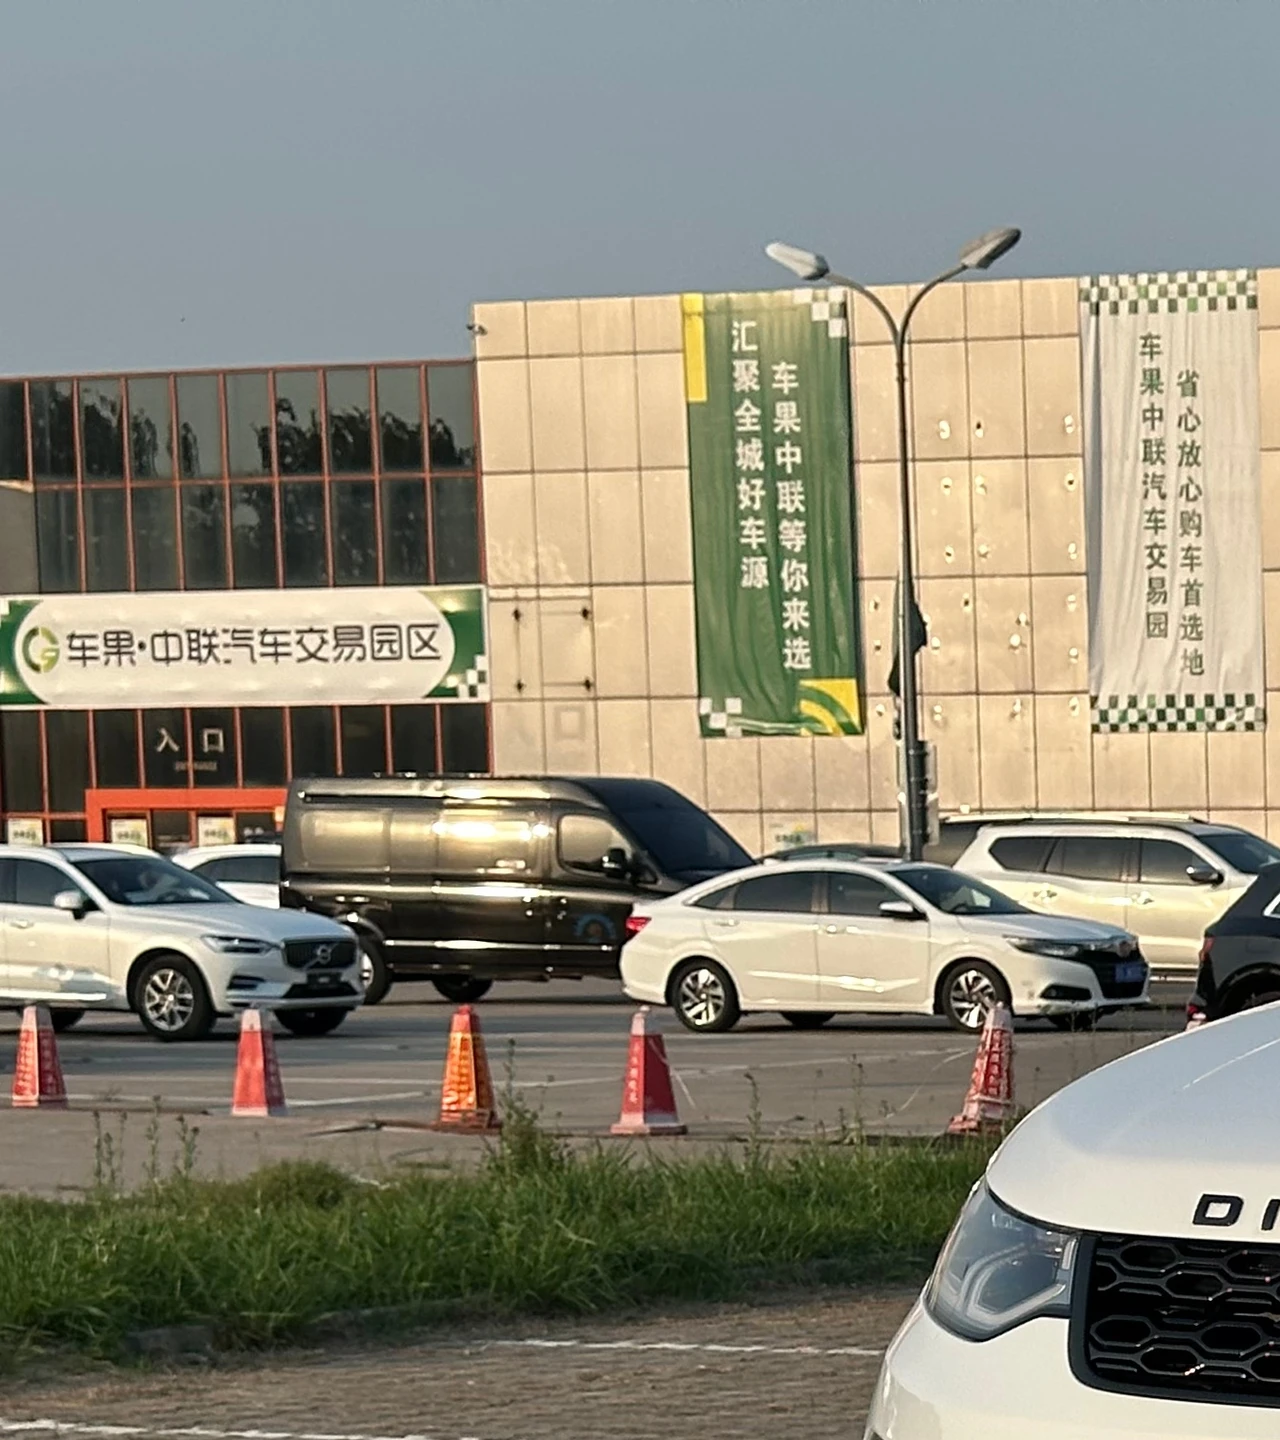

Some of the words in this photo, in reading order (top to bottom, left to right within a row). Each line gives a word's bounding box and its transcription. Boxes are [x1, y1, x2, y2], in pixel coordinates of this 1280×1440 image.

[732, 320, 769, 589] 汇聚全城好车源
[771, 361, 812, 670] 车果中联等你来选
[1139, 332, 1169, 639] 车果中联汽车交易园
[1176, 369, 1205, 677] 省心放心购车首选地
[66, 623, 442, 667] 车果·中联汽车交易园区
[156, 727, 225, 753] 入口
